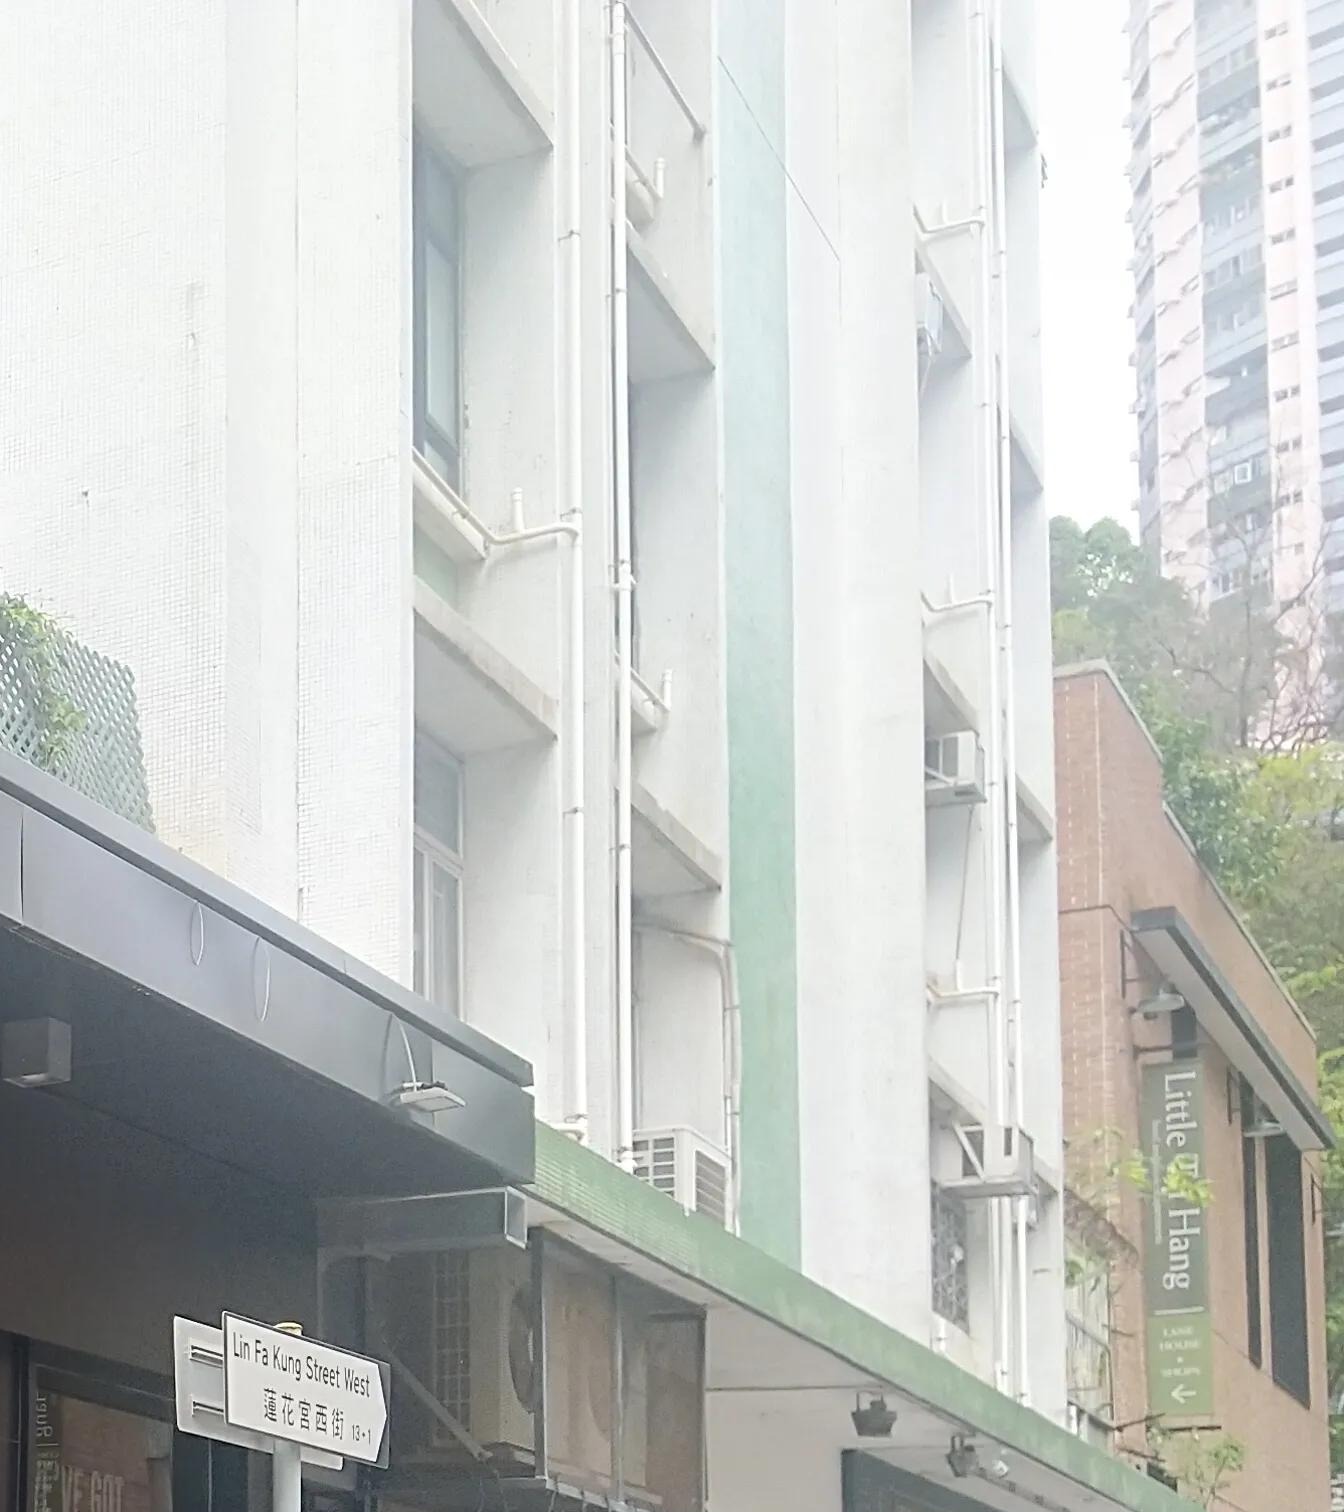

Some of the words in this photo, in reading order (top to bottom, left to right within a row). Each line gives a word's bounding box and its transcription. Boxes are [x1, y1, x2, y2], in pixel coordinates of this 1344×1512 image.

[1164, 1070, 1198, 1148] Little
[1162, 1207, 1201, 1291] Hang
[232, 1331, 251, 1361] Lin
[254, 1339, 269, 1367] Fa
[272, 1343, 302, 1381] Kung
[305, 1356, 341, 1389] Street
[343, 1367, 371, 1399] West
[263, 1386, 344, 1441] 蓮花宮西街
